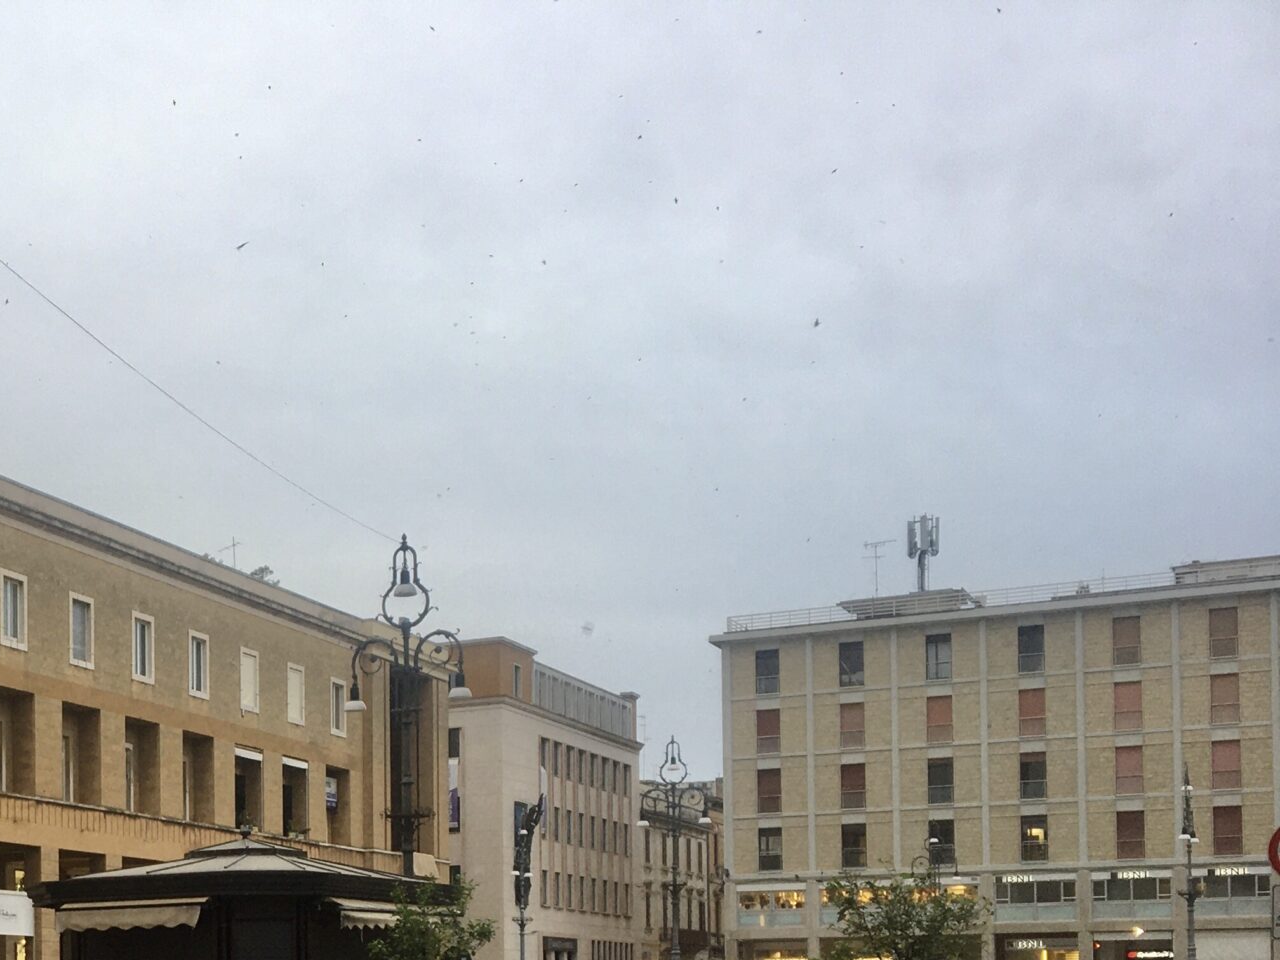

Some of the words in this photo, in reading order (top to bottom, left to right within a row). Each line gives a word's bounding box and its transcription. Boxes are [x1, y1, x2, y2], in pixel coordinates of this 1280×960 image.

[1121, 870, 1152, 880] BNL
[1219, 866, 1249, 876] BNL
[1004, 873, 1035, 883] BNL
[1017, 938, 1046, 949] BNL
